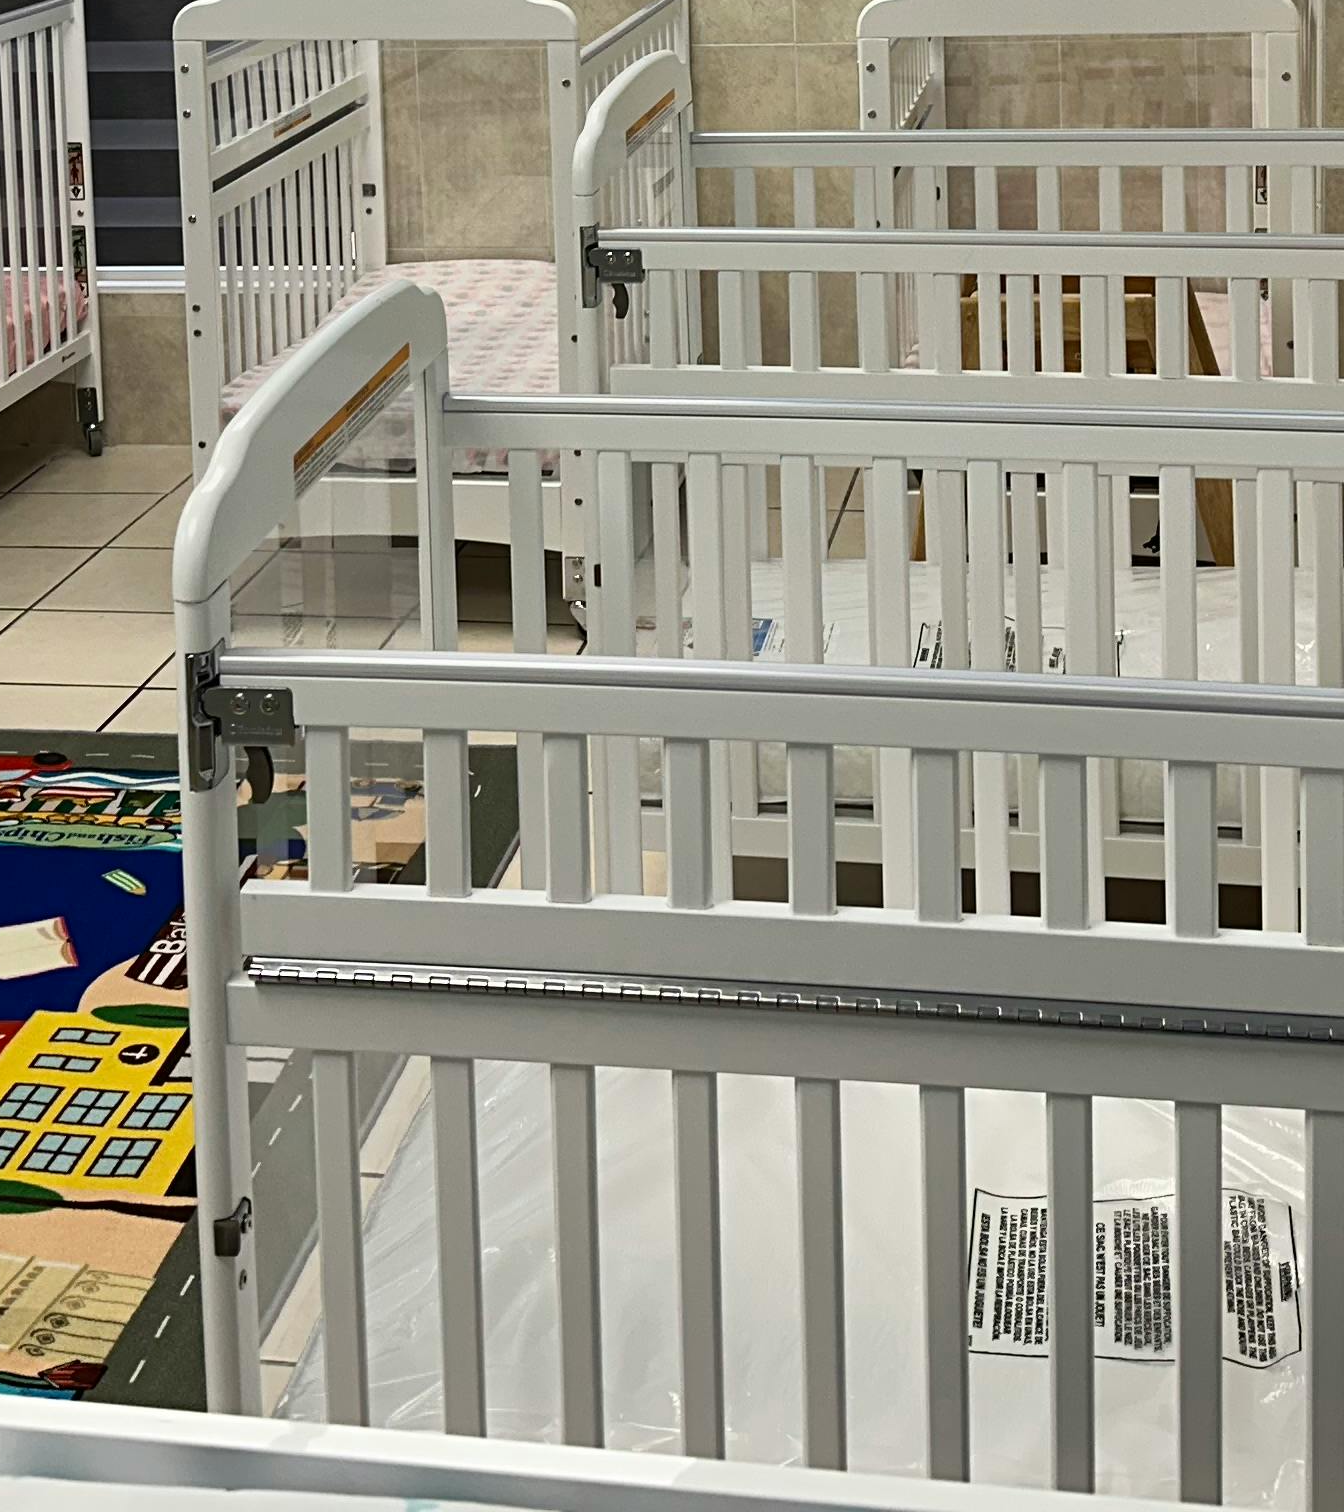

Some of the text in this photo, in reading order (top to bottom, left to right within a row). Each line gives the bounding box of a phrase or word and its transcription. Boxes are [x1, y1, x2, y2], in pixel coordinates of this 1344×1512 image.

[96, 830, 155, 848] Fish
[1096, 1223, 1104, 1233] CE
[979, 1233, 989, 1256] BOLSA
[1096, 1235, 1105, 1251] SAC
[1096, 1277, 1105, 1289] PAS
